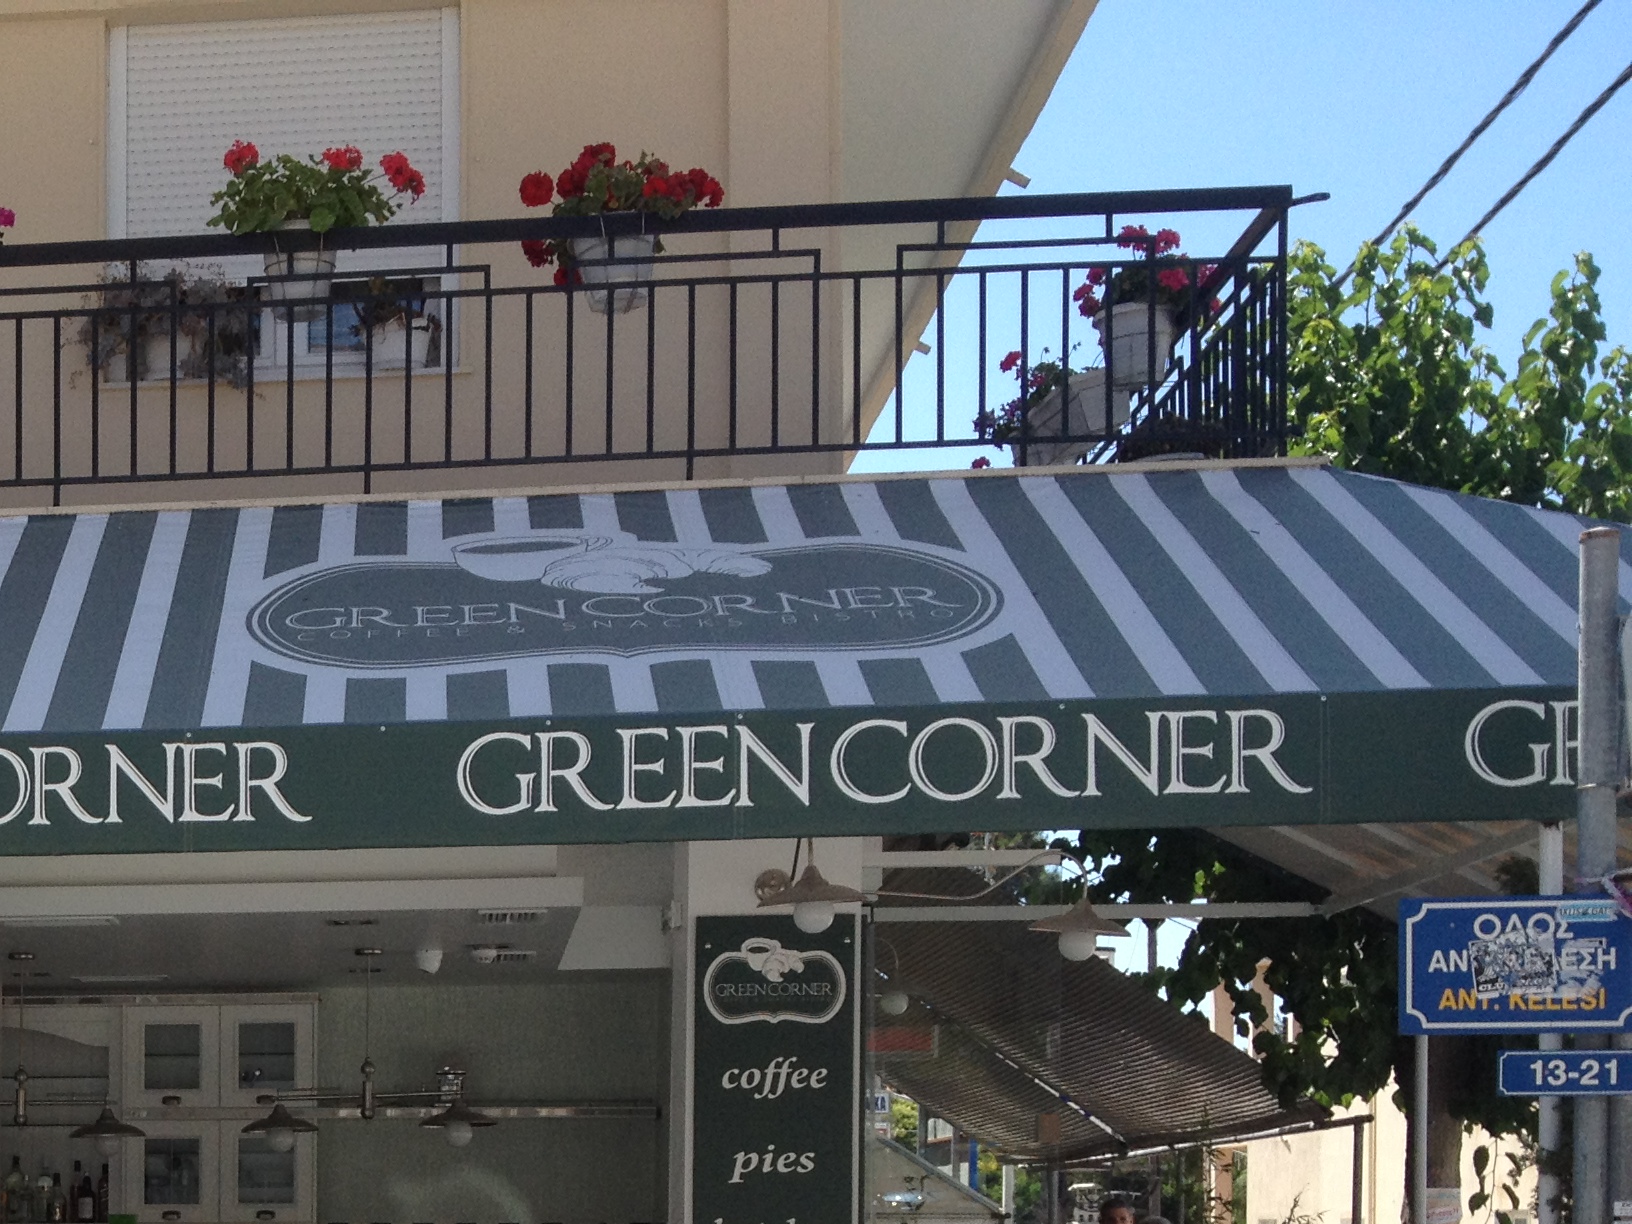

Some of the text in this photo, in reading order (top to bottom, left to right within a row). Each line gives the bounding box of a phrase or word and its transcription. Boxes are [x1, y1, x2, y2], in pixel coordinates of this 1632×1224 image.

[721, 1056, 829, 1099] coffee
[1530, 1058, 1619, 1087] 13-21
[728, 1143, 816, 1184] pies
